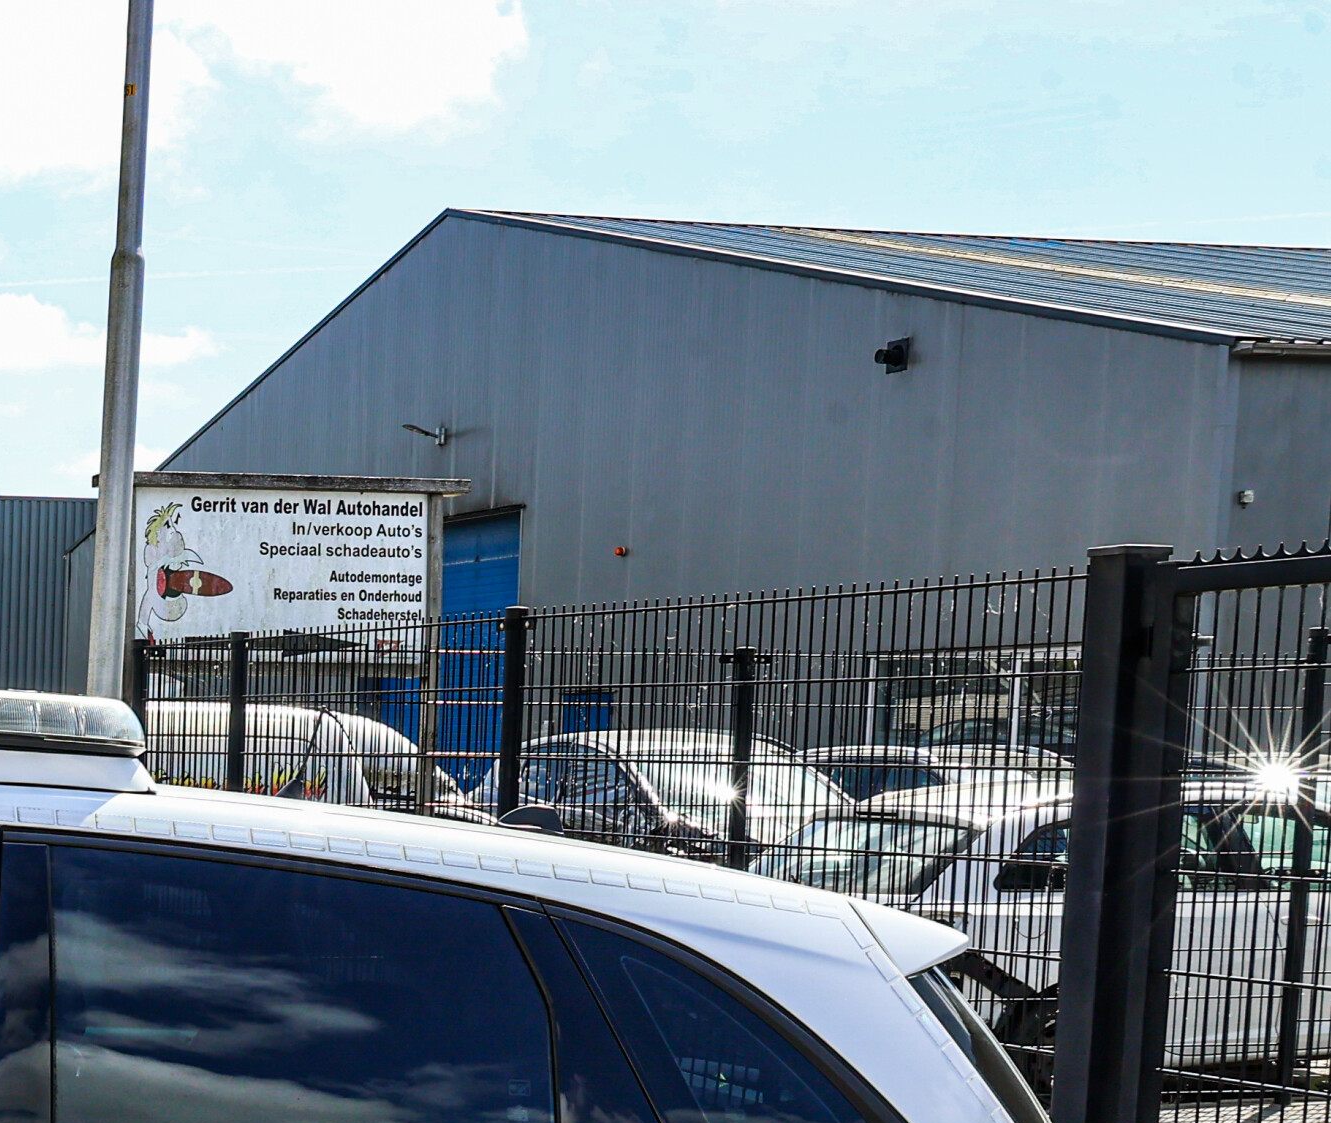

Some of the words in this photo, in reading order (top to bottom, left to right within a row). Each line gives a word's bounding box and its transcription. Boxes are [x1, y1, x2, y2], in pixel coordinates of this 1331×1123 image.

[191, 496, 237, 513] Gerrit
[241, 500, 269, 514] van
[273, 498, 300, 515] der
[303, 499, 331, 515] Wal
[336, 499, 423, 517] Autohandel
[292, 521, 372, 540] In/verkoop
[376, 523, 423, 538] Auto's
[259, 541, 321, 558] Speciaal
[326, 542, 423, 558] schadeauto's
[329, 570, 423, 587] Autodemontage
[273, 587, 337, 603] Reparaties
[341, 591, 355, 602] en
[358, 589, 422, 603] Onderhoud
[337, 607, 422, 622] Schadeherstel
